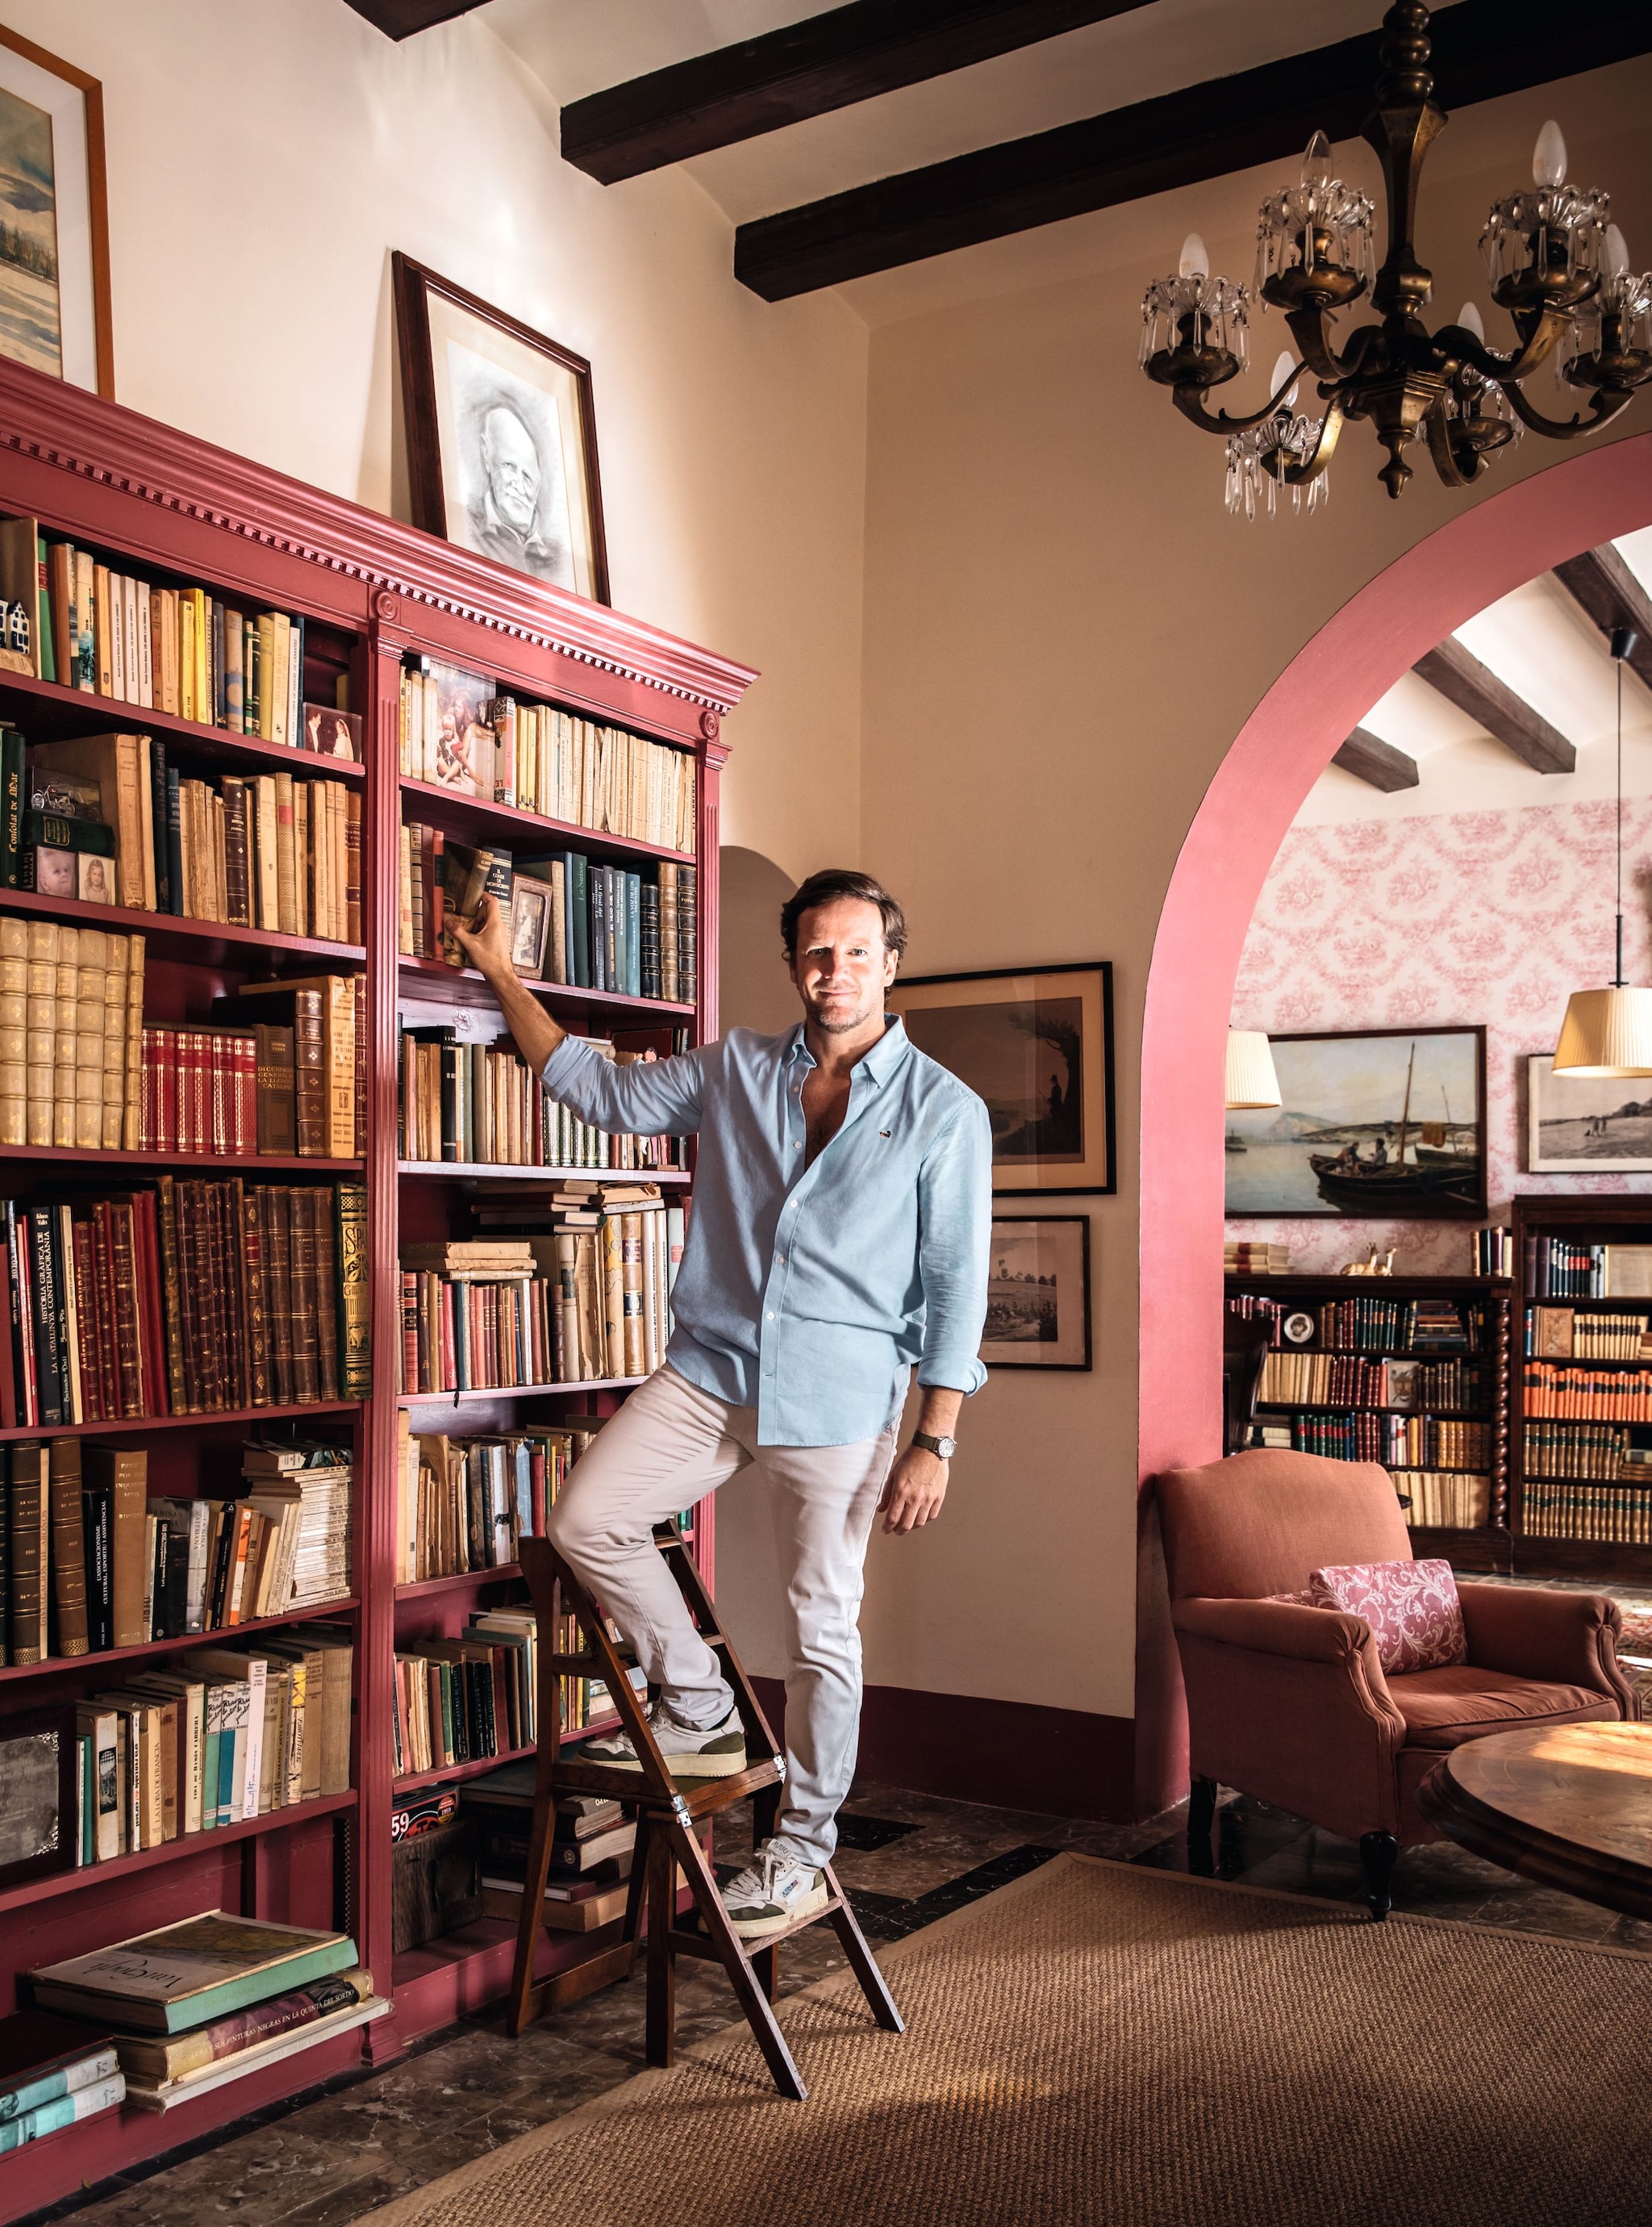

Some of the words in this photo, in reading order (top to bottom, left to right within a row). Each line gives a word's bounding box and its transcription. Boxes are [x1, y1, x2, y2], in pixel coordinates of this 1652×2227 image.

[598, 883, 603, 891] Al
[578, 889, 584, 900] La
[629, 891, 635, 900] DE
[609, 923, 615, 931] EL
[37, 1231, 44, 1243] DE
[38, 1246, 46, 1284] GRÀFICA
[44, 1231, 54, 1309] CONTEMPORÀNIA
[40, 1286, 48, 1324] HISTÒRIA
[52, 1363, 58, 1373] LA
[193, 1516, 201, 1550] ALEMANA
[40, 1549, 47, 1562] DE
[194, 1774, 198, 1782] DE
[772, 1841, 791, 1856] AUTRY
[782, 1882, 795, 1899] AUTRY
[214, 2039, 227, 2050] SUS
[227, 2028, 257, 2047] PINTURAS
[257, 2018, 281, 2033] NEGRAS
[282, 2015, 291, 2024] EN
[292, 2012, 300, 2020] LA
[300, 2002, 323, 2017] QUINTA
[323, 1997, 334, 2008] DEL
[335, 1989, 355, 2003] SORDO
